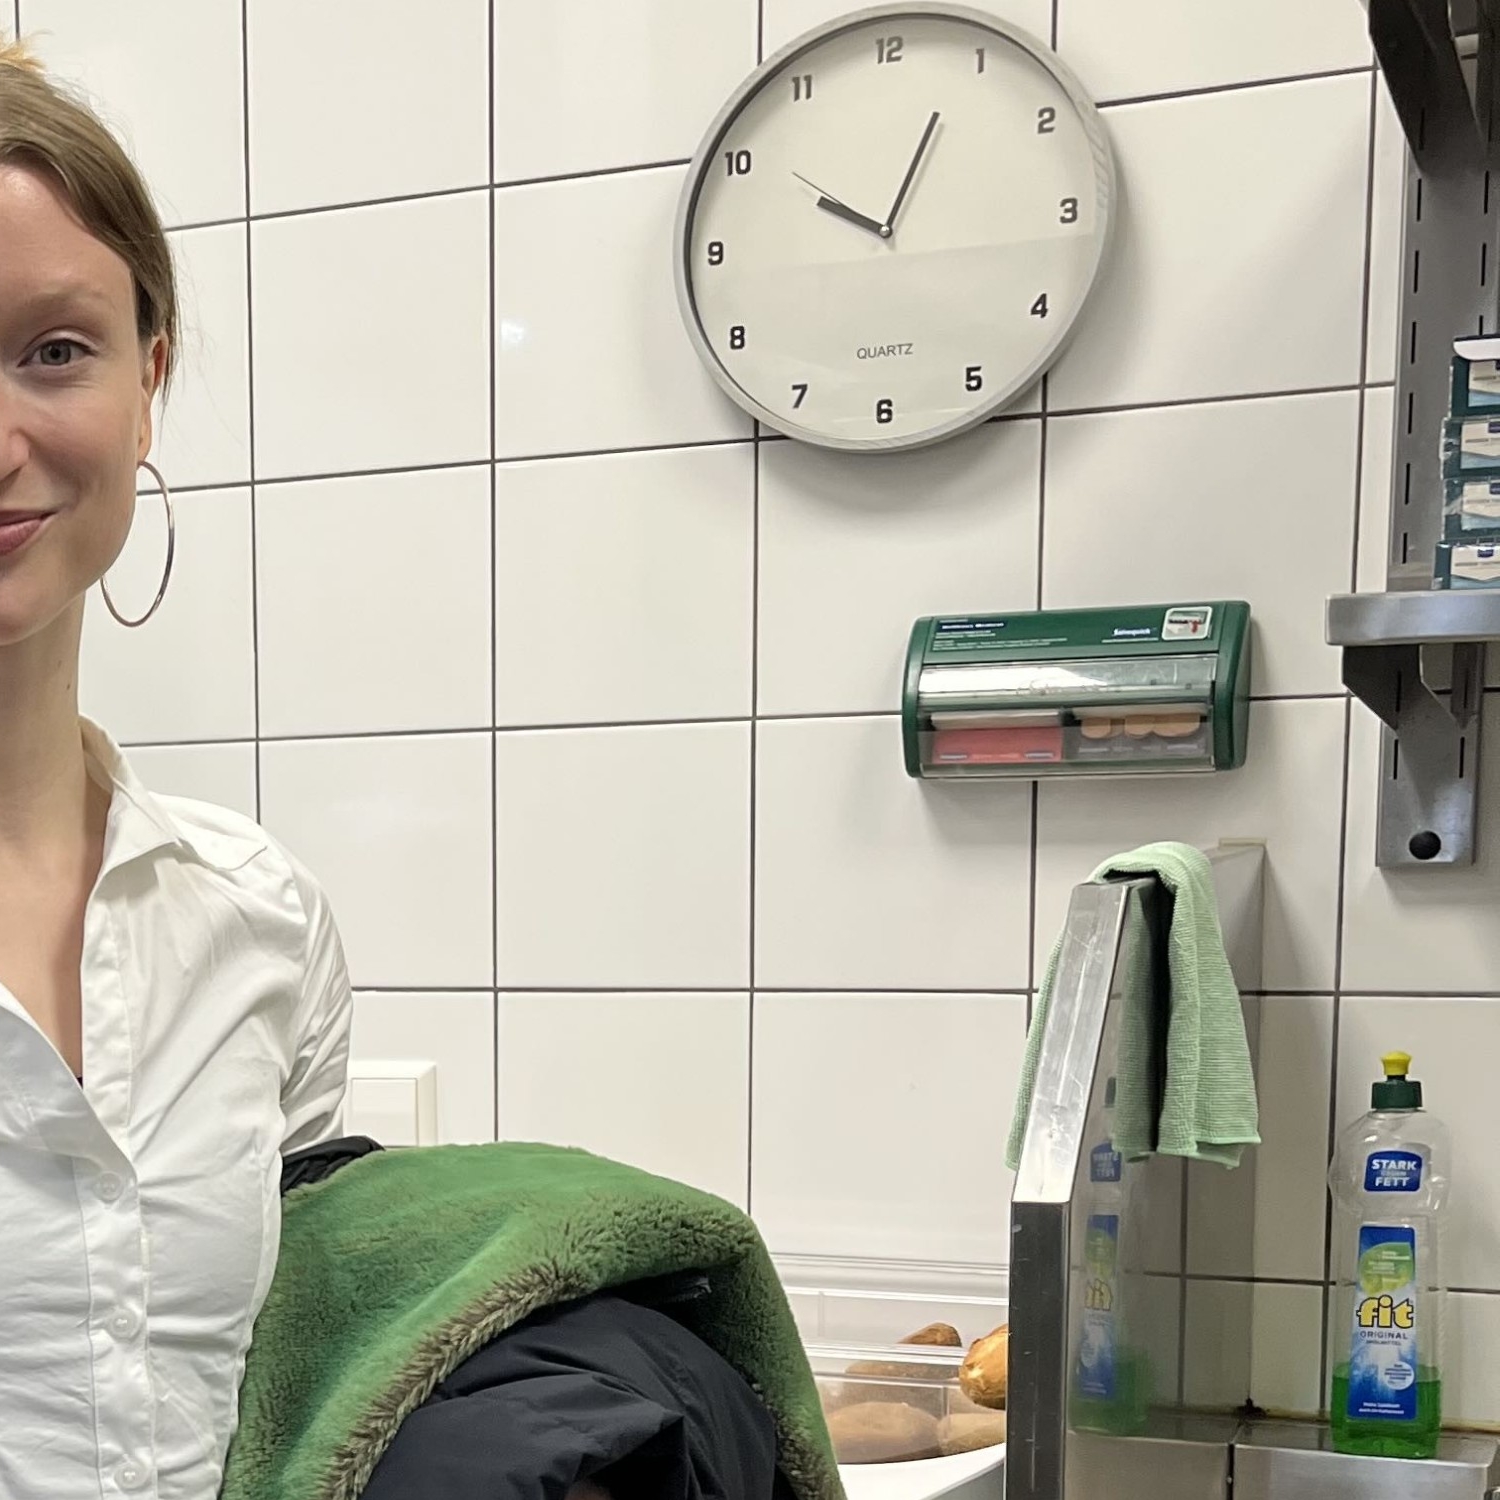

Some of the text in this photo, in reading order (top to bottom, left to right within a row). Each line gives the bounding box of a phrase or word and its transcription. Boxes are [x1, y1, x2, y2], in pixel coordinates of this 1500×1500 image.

[876, 36, 903, 64] 12
[976, 48, 985, 74] 1
[791, 75, 812, 102] 11
[1037, 107, 1056, 134] 2
[725, 150, 751, 176] 10
[1059, 198, 1078, 224] 3
[707, 241, 724, 266] 9
[1031, 293, 1048, 318] 4
[729, 325, 745, 350] 8
[856, 343, 913, 360] QUARTZ
[965, 366, 982, 392] 5
[791, 384, 808, 409] 7
[876, 399, 893, 424] 6
[1371, 1158, 1417, 1170] STARK
[1375, 1176, 1410, 1187] FETT
[1356, 1294, 1414, 1330] fit
[1359, 1330, 1408, 1340] ORIGINAL
